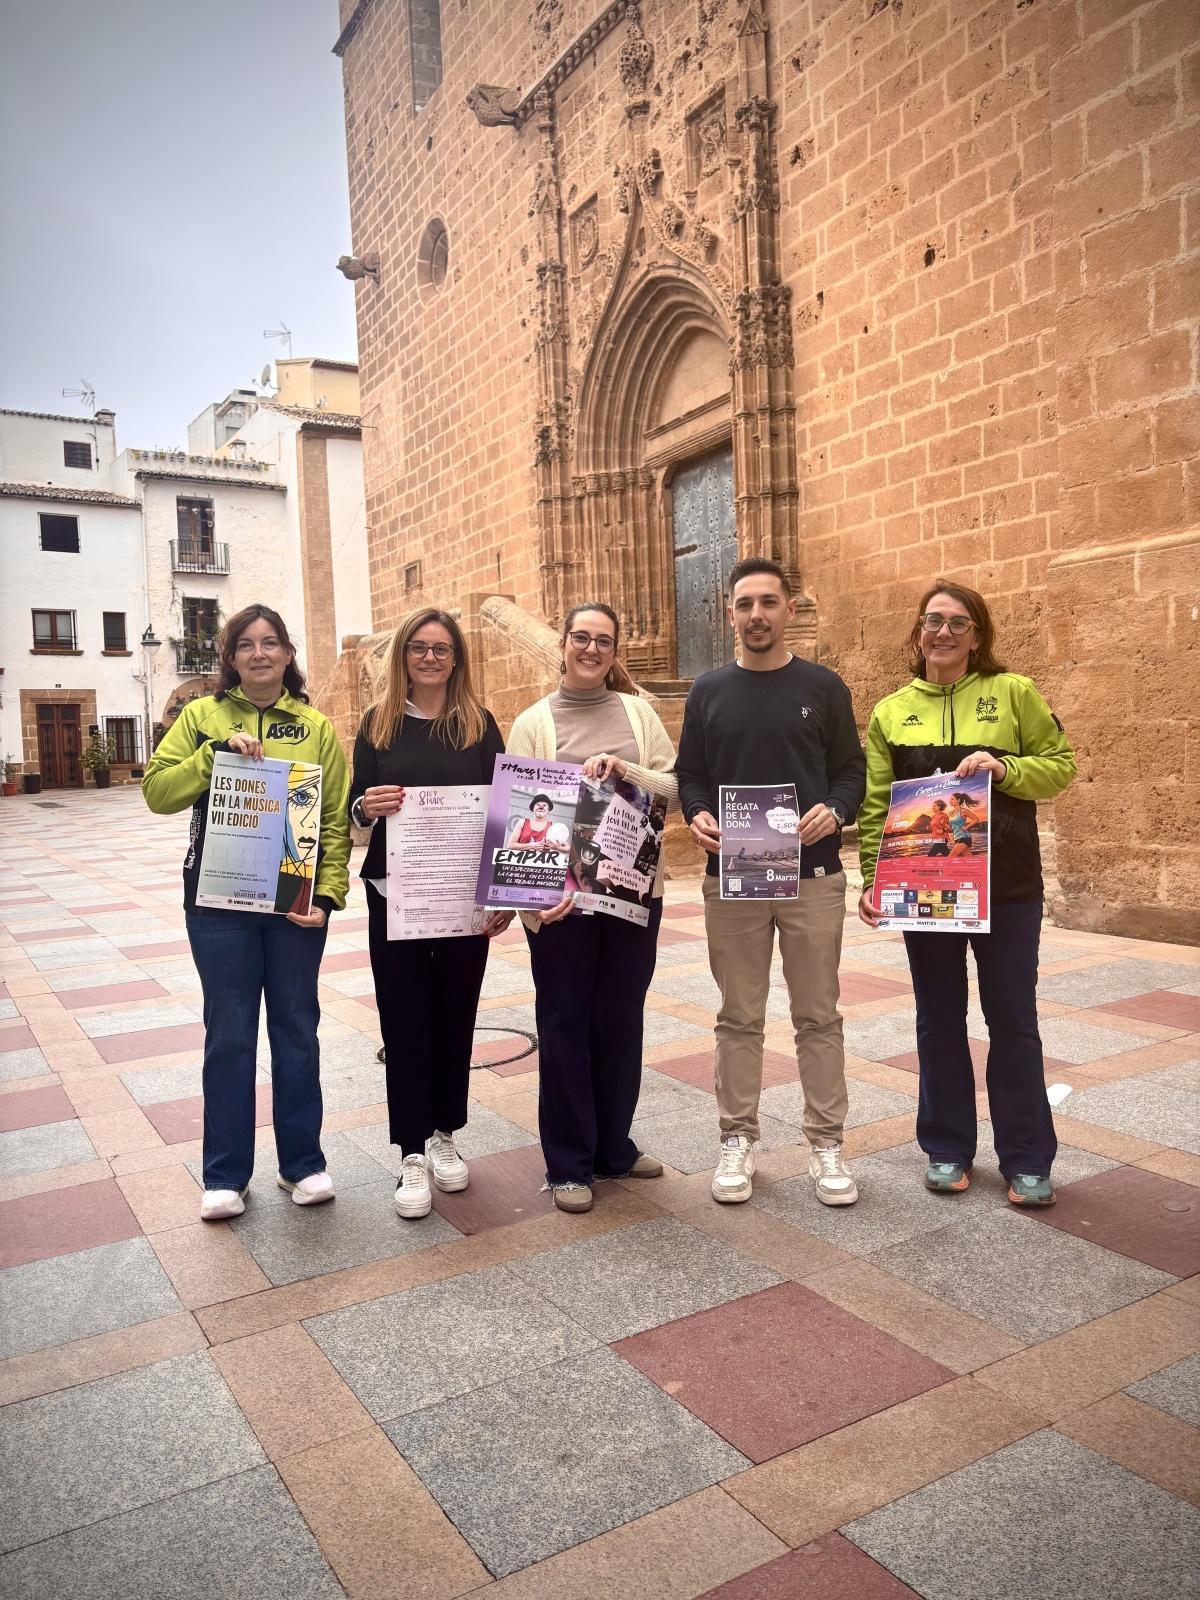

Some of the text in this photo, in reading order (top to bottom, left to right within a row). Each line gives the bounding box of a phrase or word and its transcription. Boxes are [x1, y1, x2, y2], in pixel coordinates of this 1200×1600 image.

[265, 722, 305, 740] Asevi
[214, 775, 267, 795] LES DONES
[212, 793, 281, 813] EN LA MÚSICA
[418, 790, 427, 806] 8
[725, 792, 737, 802] IV
[725, 802, 760, 811] REGATA
[211, 810, 259, 829] VII EDICIÓ
[726, 811, 752, 820] DE LA
[726, 820, 751, 829] DONA
[494, 849, 560, 867] EMPAR
[766, 869, 797, 882] 8 Marzo
